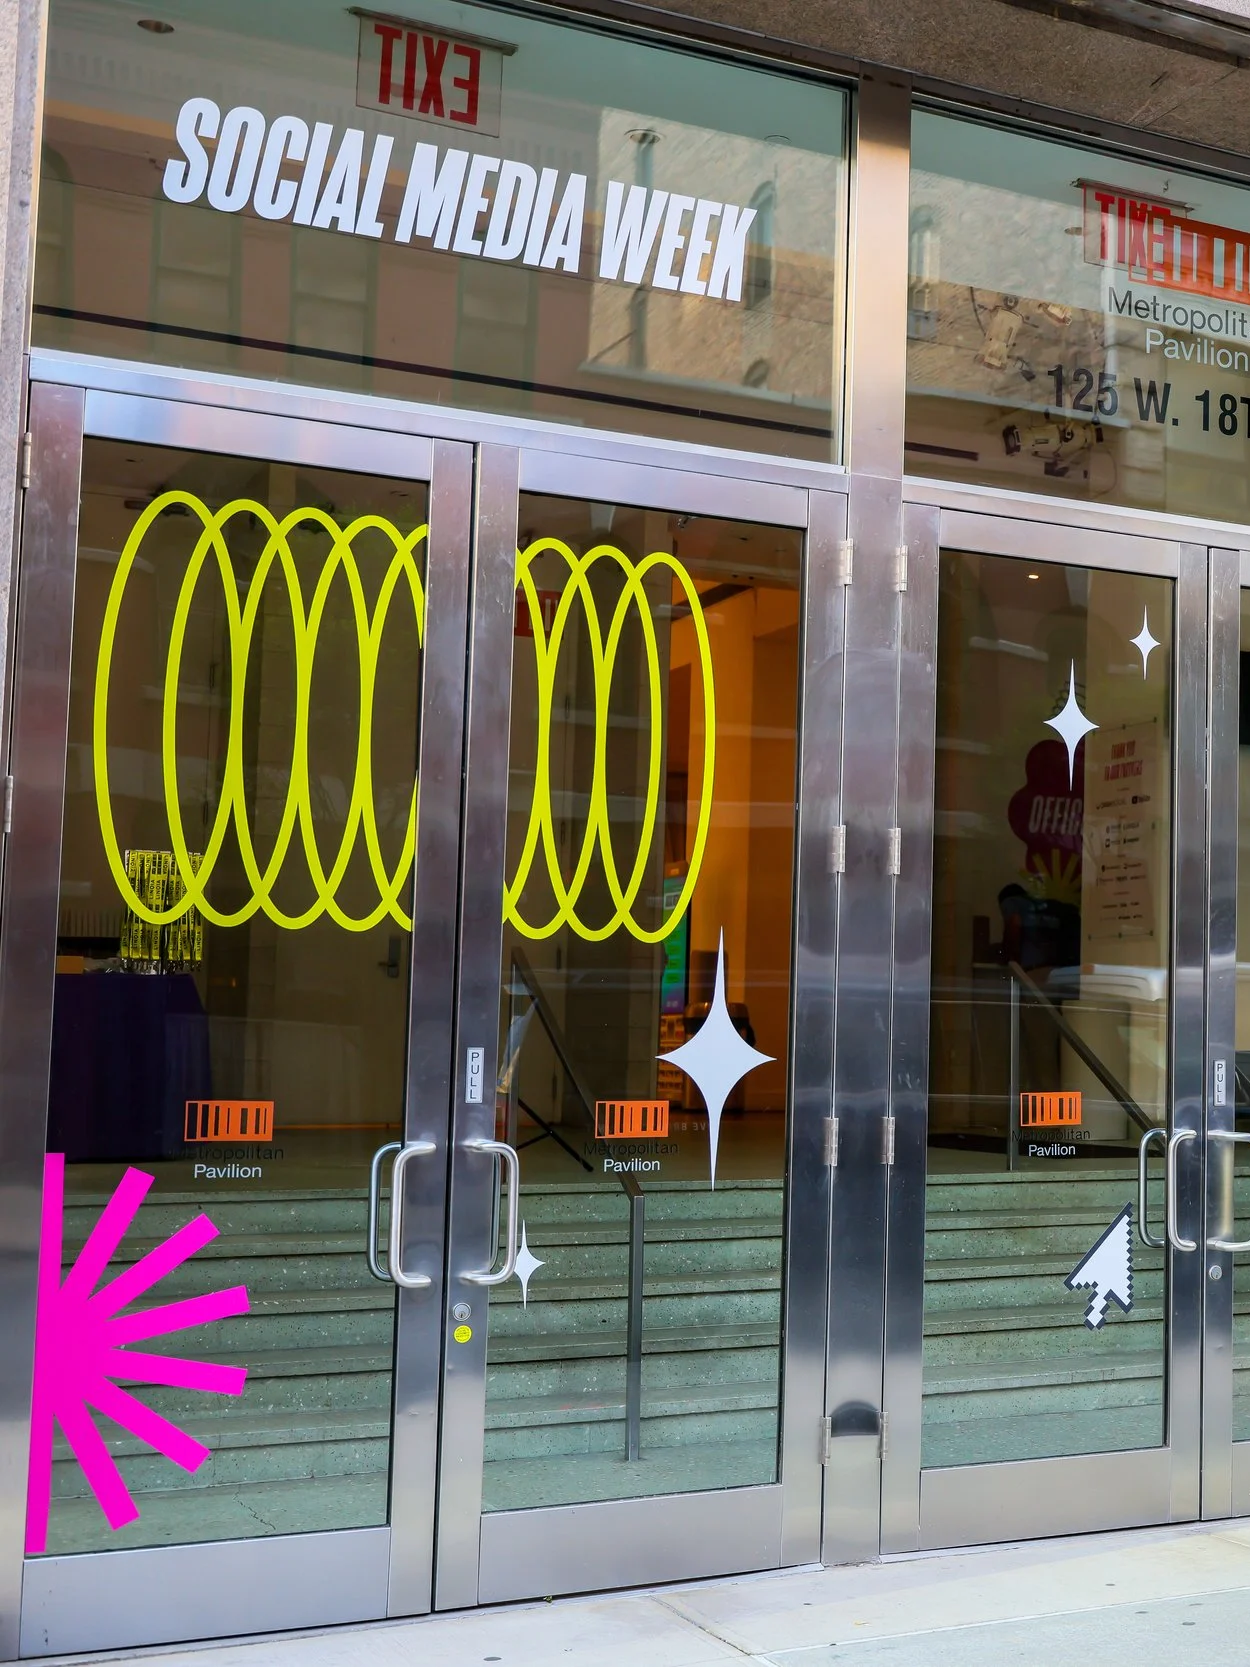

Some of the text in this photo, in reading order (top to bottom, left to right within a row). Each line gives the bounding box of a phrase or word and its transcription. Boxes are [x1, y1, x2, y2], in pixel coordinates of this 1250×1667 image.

[162, 97, 758, 302] SOCIAL MEDIA WEEK
[1145, 328, 1250, 372] Pavilion
[1047, 363, 1119, 416] 125
[1133, 377, 1179, 427] W.
[1028, 795, 1084, 836] OFFIC
[470, 1051, 480, 1100] PULL
[584, 1141, 680, 1157] Metropolitan
[603, 1158, 661, 1173] Pavilion
[1028, 1143, 1076, 1157] Pavilion
[194, 1163, 262, 1179] Pavilion
